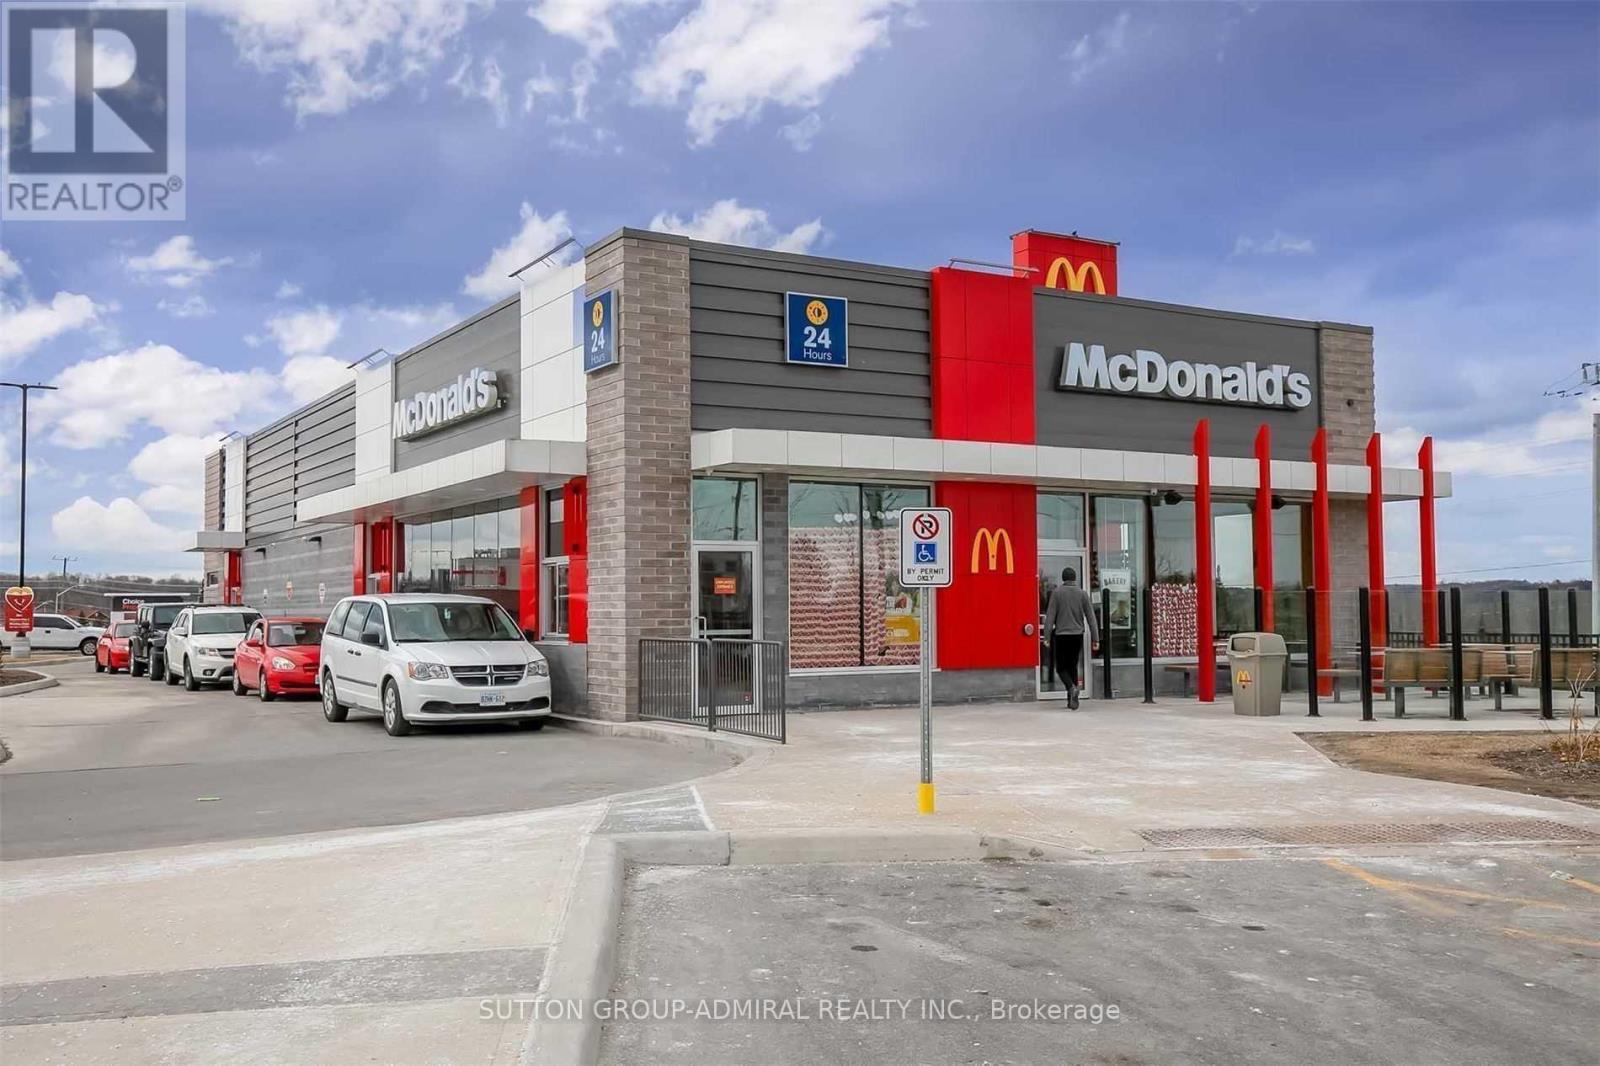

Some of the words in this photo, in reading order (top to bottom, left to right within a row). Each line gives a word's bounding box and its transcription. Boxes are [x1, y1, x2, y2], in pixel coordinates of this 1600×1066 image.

[591, 327, 606, 353] 24
[803, 326, 832, 349] 24
[590, 351, 606, 366] Hours
[803, 347, 833, 361] Hours
[1060, 342, 1312, 409] McDonald's
[391, 367, 499, 440] McDonald's
